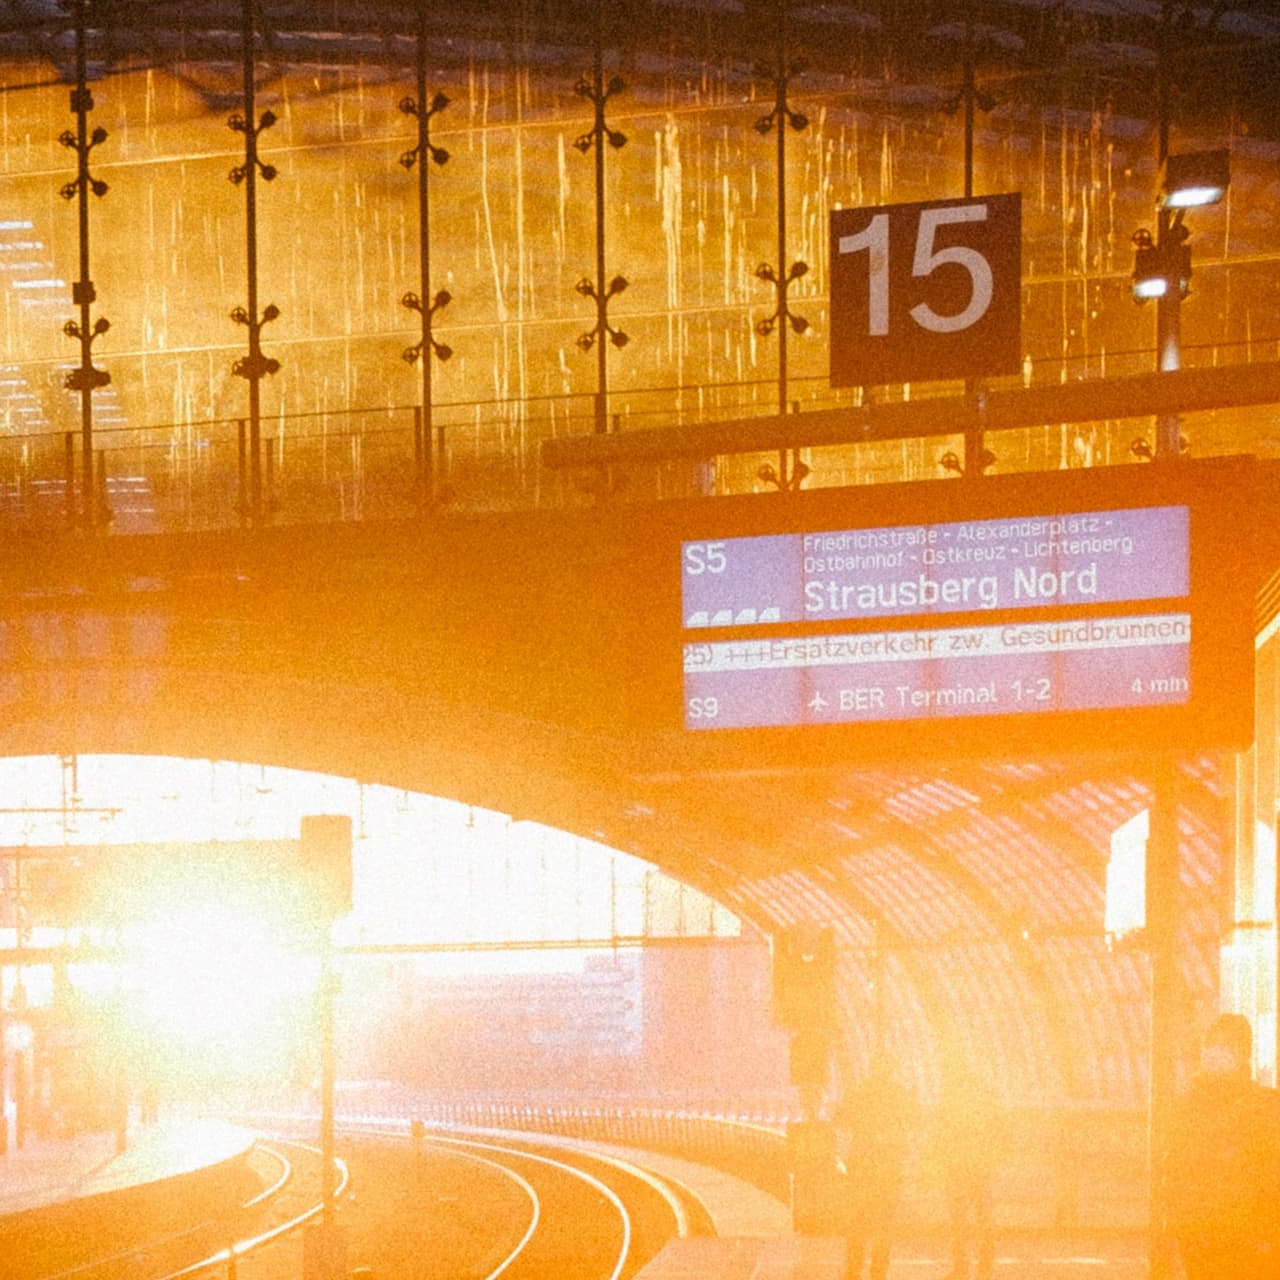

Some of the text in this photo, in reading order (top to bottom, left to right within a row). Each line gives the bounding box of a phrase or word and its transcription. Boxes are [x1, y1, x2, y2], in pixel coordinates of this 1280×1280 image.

[839, 204, 993, 337] 15
[803, 527, 938, 553] Friedrichstraße
[957, 517, 1100, 541] Alexanderplatz
[803, 550, 904, 574] Ostbahnhof
[922, 544, 1007, 565] Ostkreuz
[1023, 535, 1133, 558] Lichtenberg
[685, 542, 727, 575] S5
[804, 562, 1097, 613] Strausberg Nord
[949, 633, 990, 650] zw.
[688, 696, 719, 719] S9
[839, 686, 885, 711] BER
[896, 681, 997, 706] Terminal
[1010, 677, 1052, 701] 1-2
[1150, 676, 1189, 693] min
